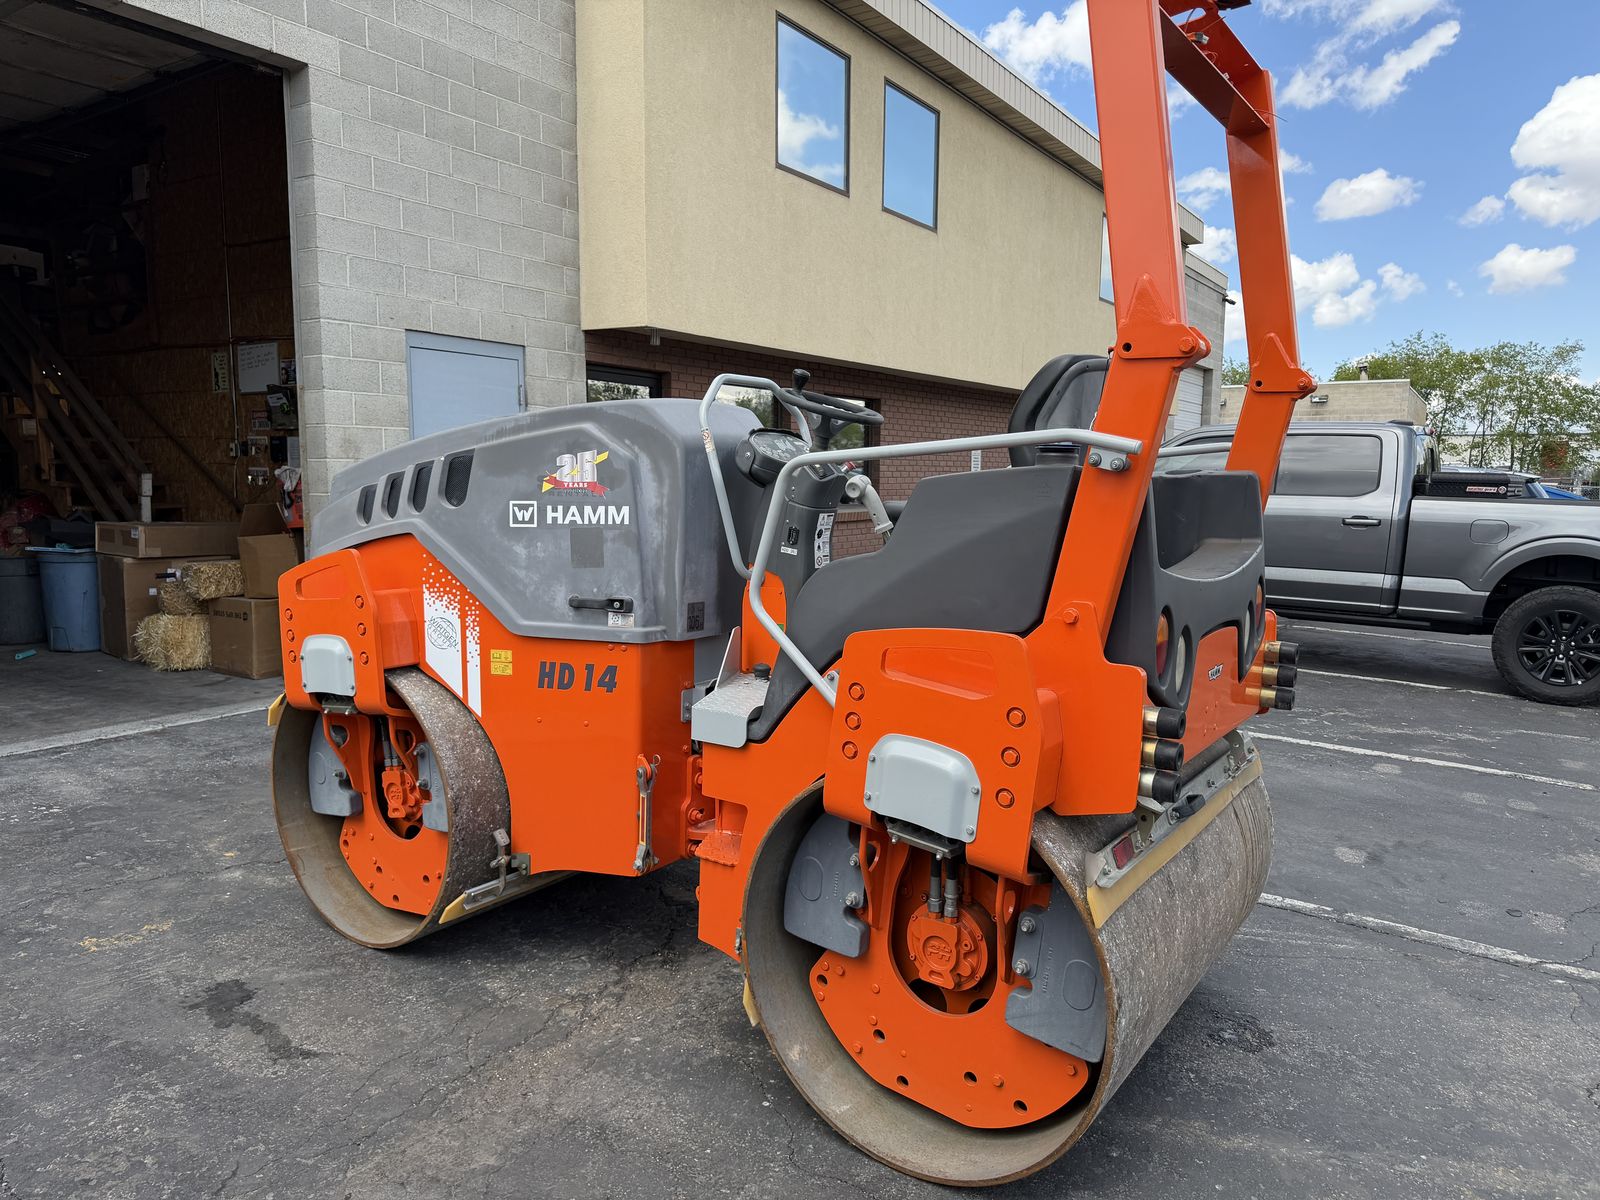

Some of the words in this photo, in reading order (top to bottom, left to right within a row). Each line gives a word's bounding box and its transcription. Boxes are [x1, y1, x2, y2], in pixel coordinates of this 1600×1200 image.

[546, 505, 630, 525] HAMM
[427, 616, 459, 647] WIRTGEN
[427, 623, 453, 647] GROUP
[537, 661, 576, 690] HD
[583, 663, 618, 693] 14
